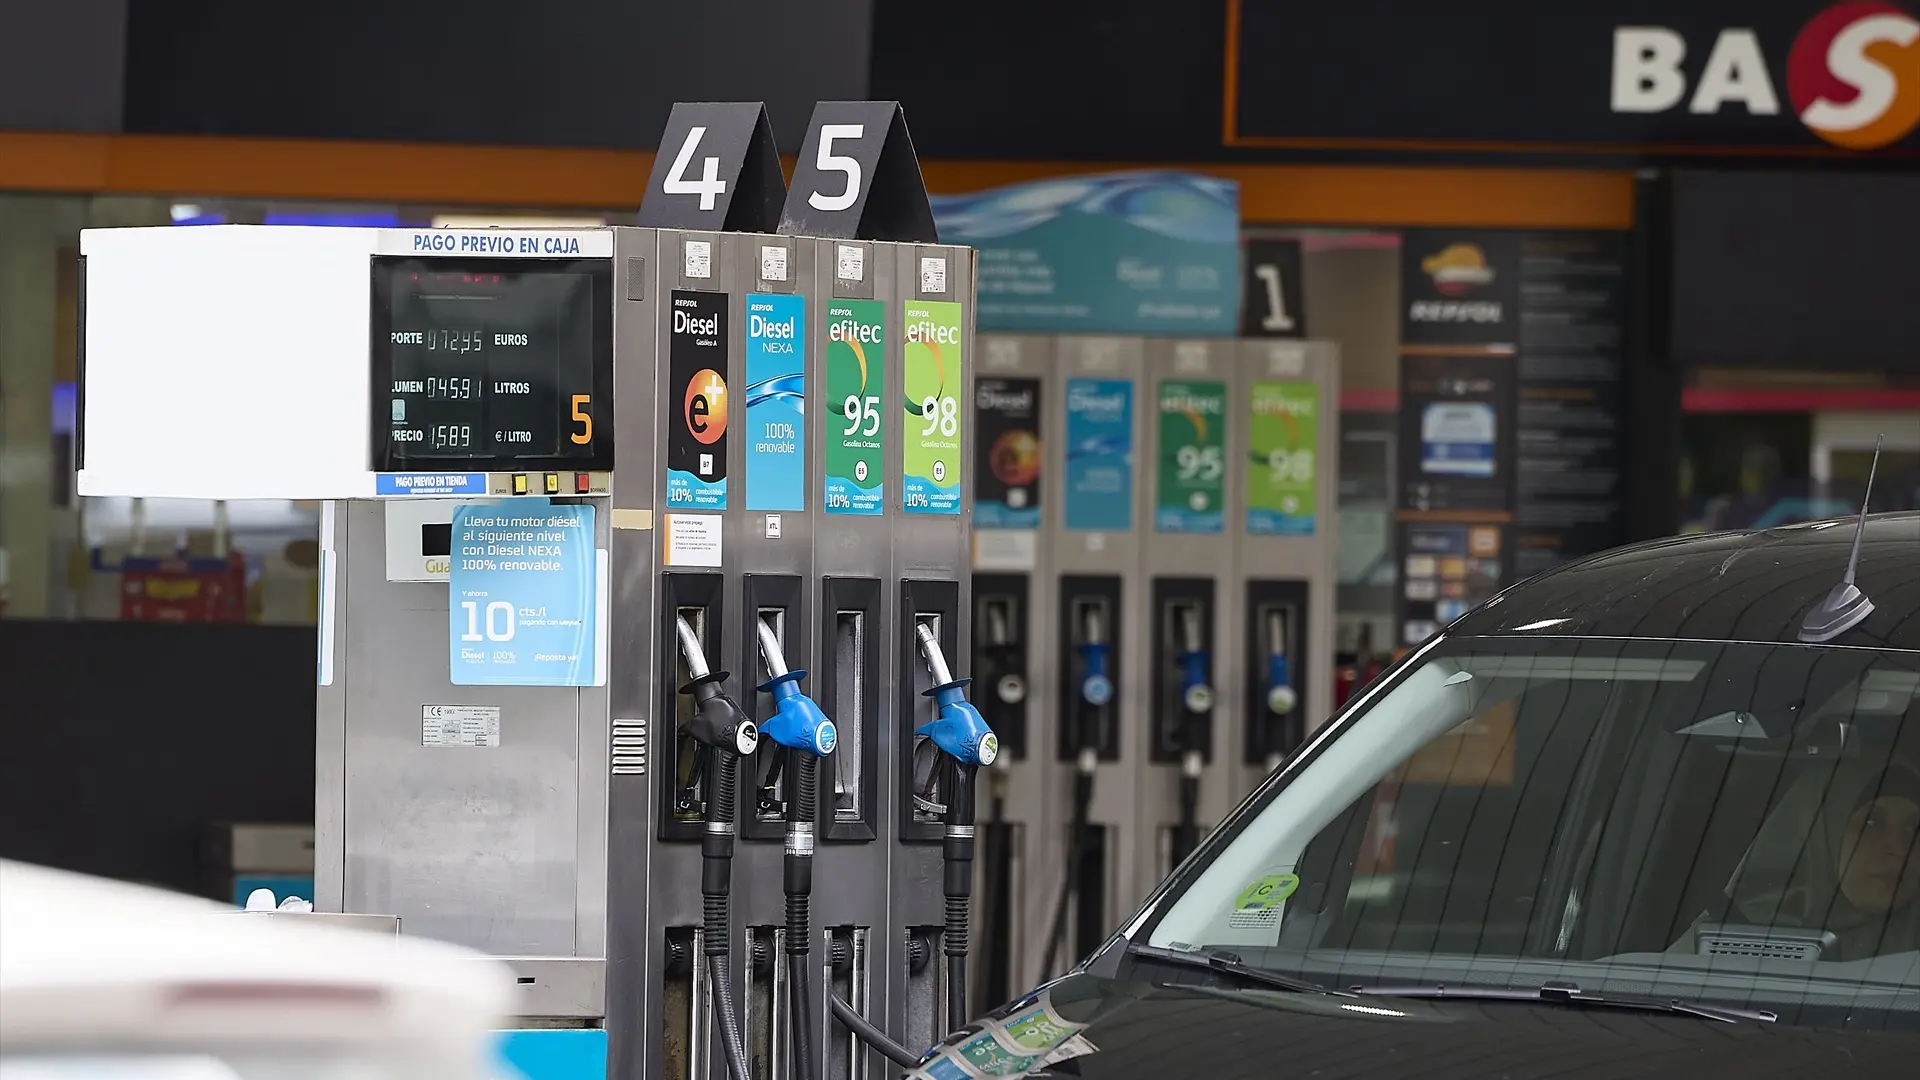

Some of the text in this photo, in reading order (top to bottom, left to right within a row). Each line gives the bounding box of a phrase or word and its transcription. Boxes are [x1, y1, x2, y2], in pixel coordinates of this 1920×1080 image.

[663, 126, 727, 211] 4
[807, 124, 865, 211] 5
[413, 234, 580, 254] PAGO PREVIO EN CAJA
[674, 299, 698, 308] REPSOL
[1255, 264, 1295, 330] 1
[750, 303, 774, 312] REPSOL
[830, 308, 853, 317] REPSOL
[907, 309, 930, 318] REPSOL
[674, 310, 718, 336] Diesel
[750, 314, 794, 339] Diesel
[829, 319, 882, 344] efitec
[907, 321, 959, 345] efitec
[494, 333, 528, 346] EUROS
[762, 342, 794, 354] NEXA
[391, 380, 424, 394] UMEN
[494, 382, 530, 394] LITROS
[570, 394, 593, 445] 5
[843, 395, 881, 438] 95
[921, 395, 957, 438] 98
[764, 422, 795, 439] 100%
[755, 440, 795, 454] renovable
[843, 440, 881, 449] Gasolina Octanos
[1177, 446, 1223, 480] 95
[395, 475, 468, 488] PAGO PREVIO EN TIENDA
[670, 488, 693, 502] 10%
[695, 488, 724, 496] combustible
[852, 494, 880, 502] combustible
[930, 493, 957, 501] combustible
[695, 496, 718, 504] renovable
[828, 493, 850, 508] 10%
[852, 502, 875, 510] renovable
[906, 493, 928, 507] 10%
[464, 515, 581, 528] Lleva tu motor diésel
[463, 530, 567, 543] al siguiente nivel
[462, 545, 562, 556] con Diesel NEXA
[462, 559, 564, 571] 100% renovable.
[461, 601, 515, 642] 10
[519, 619, 546, 627] pagando
[461, 651, 485, 659] Diesel
[492, 650, 516, 660] 100%
